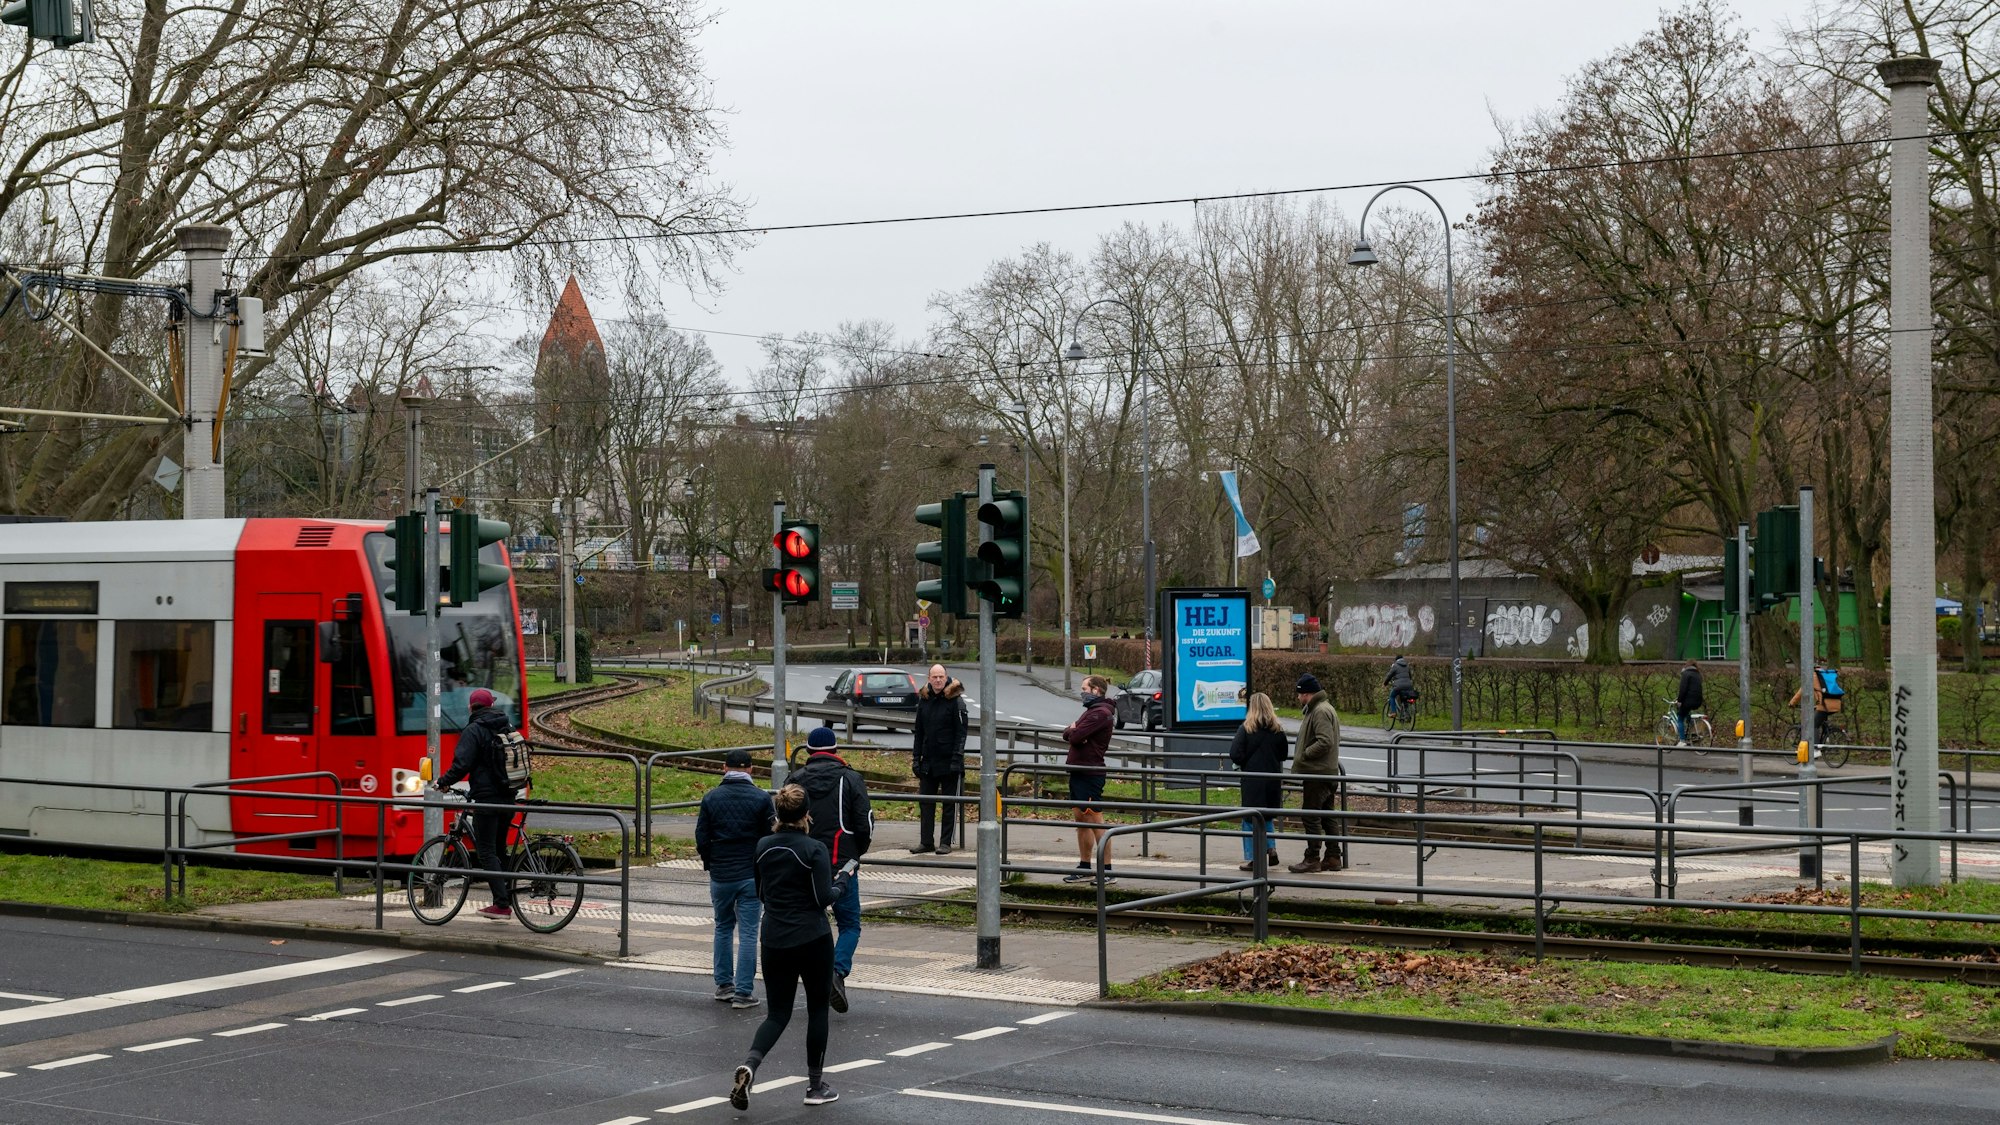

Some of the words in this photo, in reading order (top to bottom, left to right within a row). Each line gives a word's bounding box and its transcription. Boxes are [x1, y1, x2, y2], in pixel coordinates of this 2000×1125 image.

[1192, 629, 1205, 637] DIE
[1206, 628, 1241, 636] ZUKUNFT
[1189, 646, 1235, 657] SUGAR.
